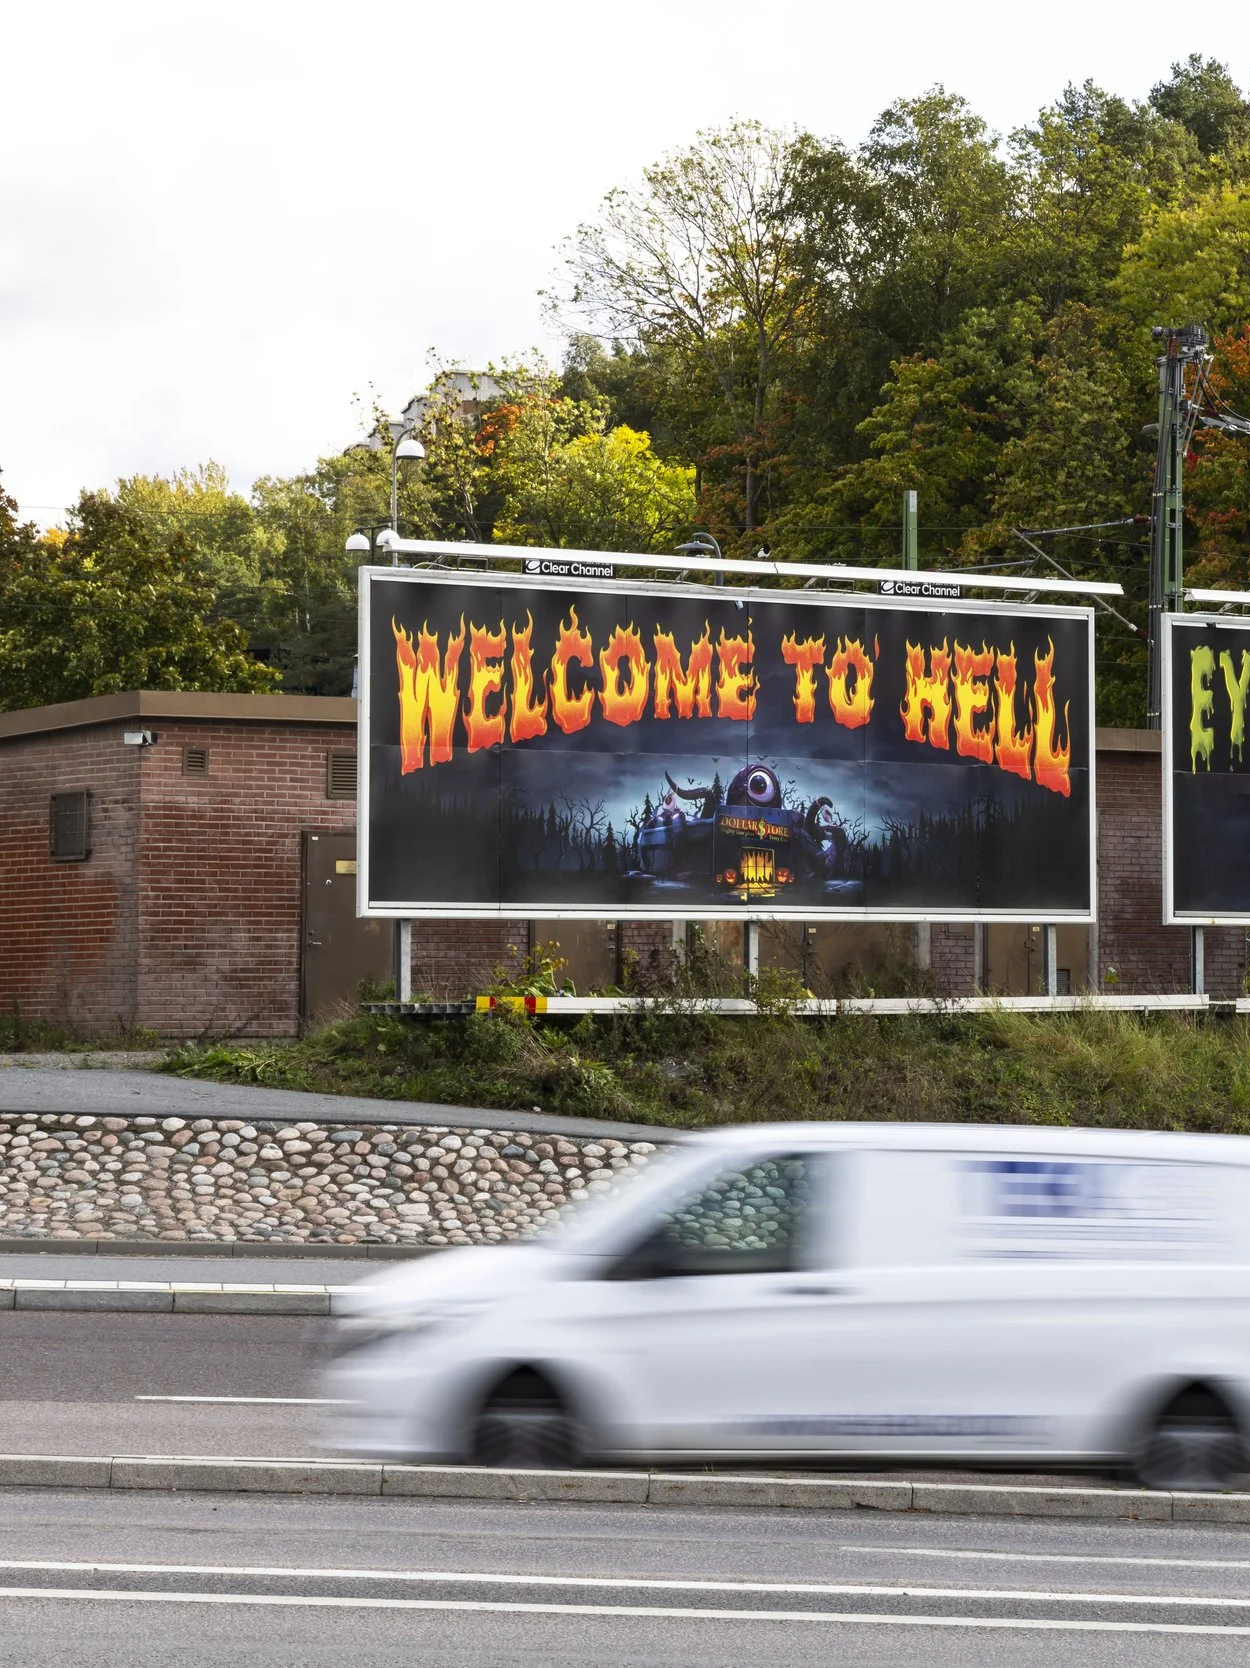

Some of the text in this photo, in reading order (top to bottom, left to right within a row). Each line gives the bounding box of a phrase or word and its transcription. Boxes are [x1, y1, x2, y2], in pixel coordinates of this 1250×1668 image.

[541, 561, 614, 577] Clear Channel
[895, 582, 960, 597] Clear Channel
[392, 604, 1071, 798] WELCOME TO HELL
